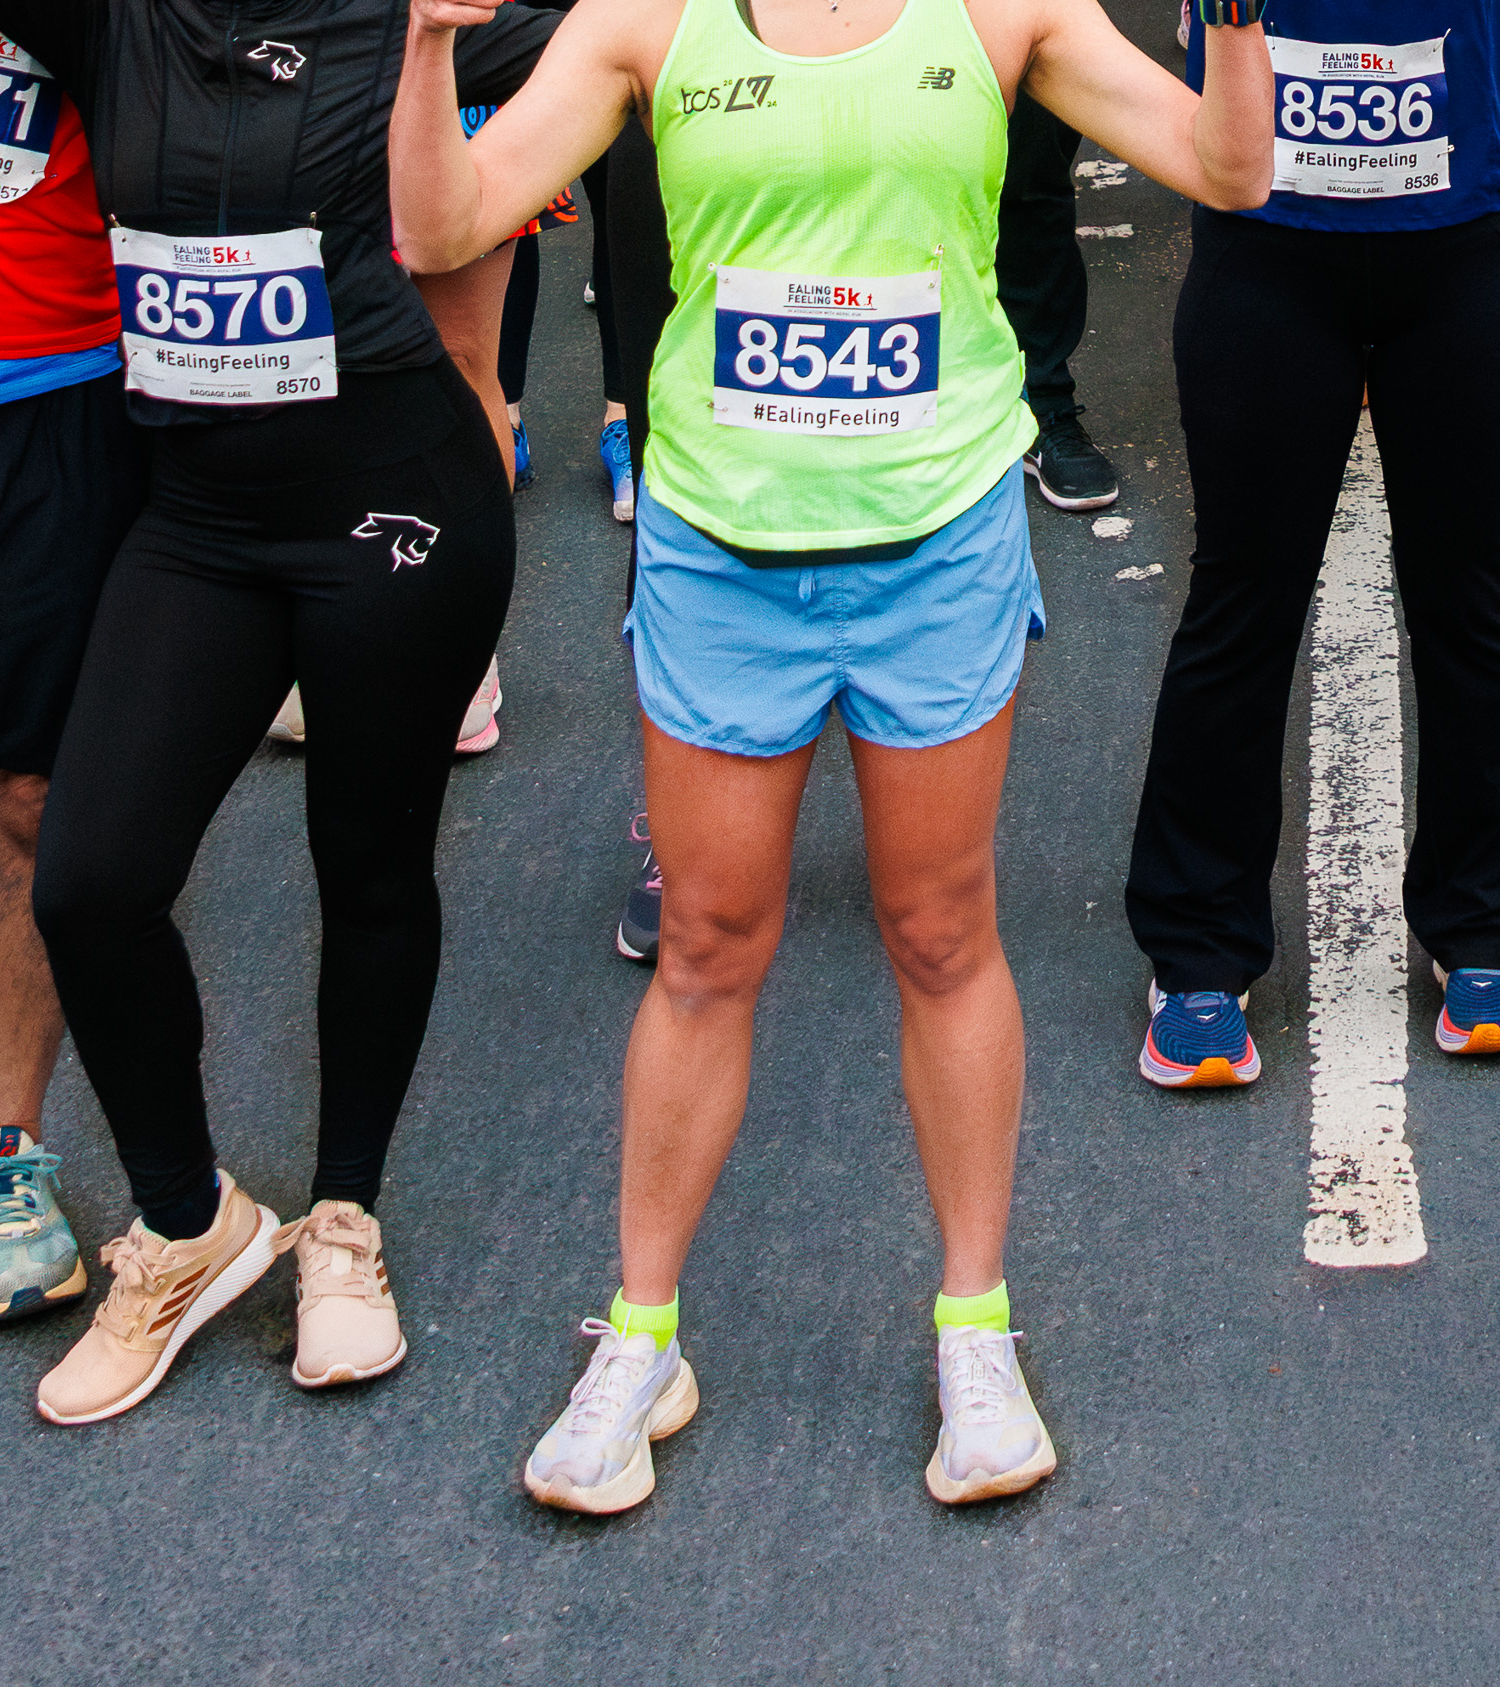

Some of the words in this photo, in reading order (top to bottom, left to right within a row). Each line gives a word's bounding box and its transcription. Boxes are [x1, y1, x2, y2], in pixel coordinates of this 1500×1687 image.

[1322, 52, 1359, 61] EALING
[1322, 61, 1359, 69] FEELING
[1360, 53, 1384, 70] 5k
[681, 82, 721, 115] tcs
[1281, 81, 1433, 141] 8536
[1294, 150, 1417, 171] #EalingFeeling
[1327, 185, 1361, 194] BAGGAGE
[1404, 173, 1439, 190] 8536
[174, 244, 211, 255] EALING
[213, 246, 239, 264] 5k
[174, 253, 211, 264] FEELING
[788, 283, 831, 295] EALING
[833, 287, 861, 306] 5k
[136, 273, 307, 340] 8570
[788, 294, 831, 305] FEELING
[156, 348, 290, 373] #EalingFeeling
[735, 319, 921, 392] 8543
[189, 388, 226, 397] BAGGAGE
[227, 390, 252, 398] LABEL
[276, 376, 321, 395] 8570
[753, 403, 900, 429] #EalingFeeling
